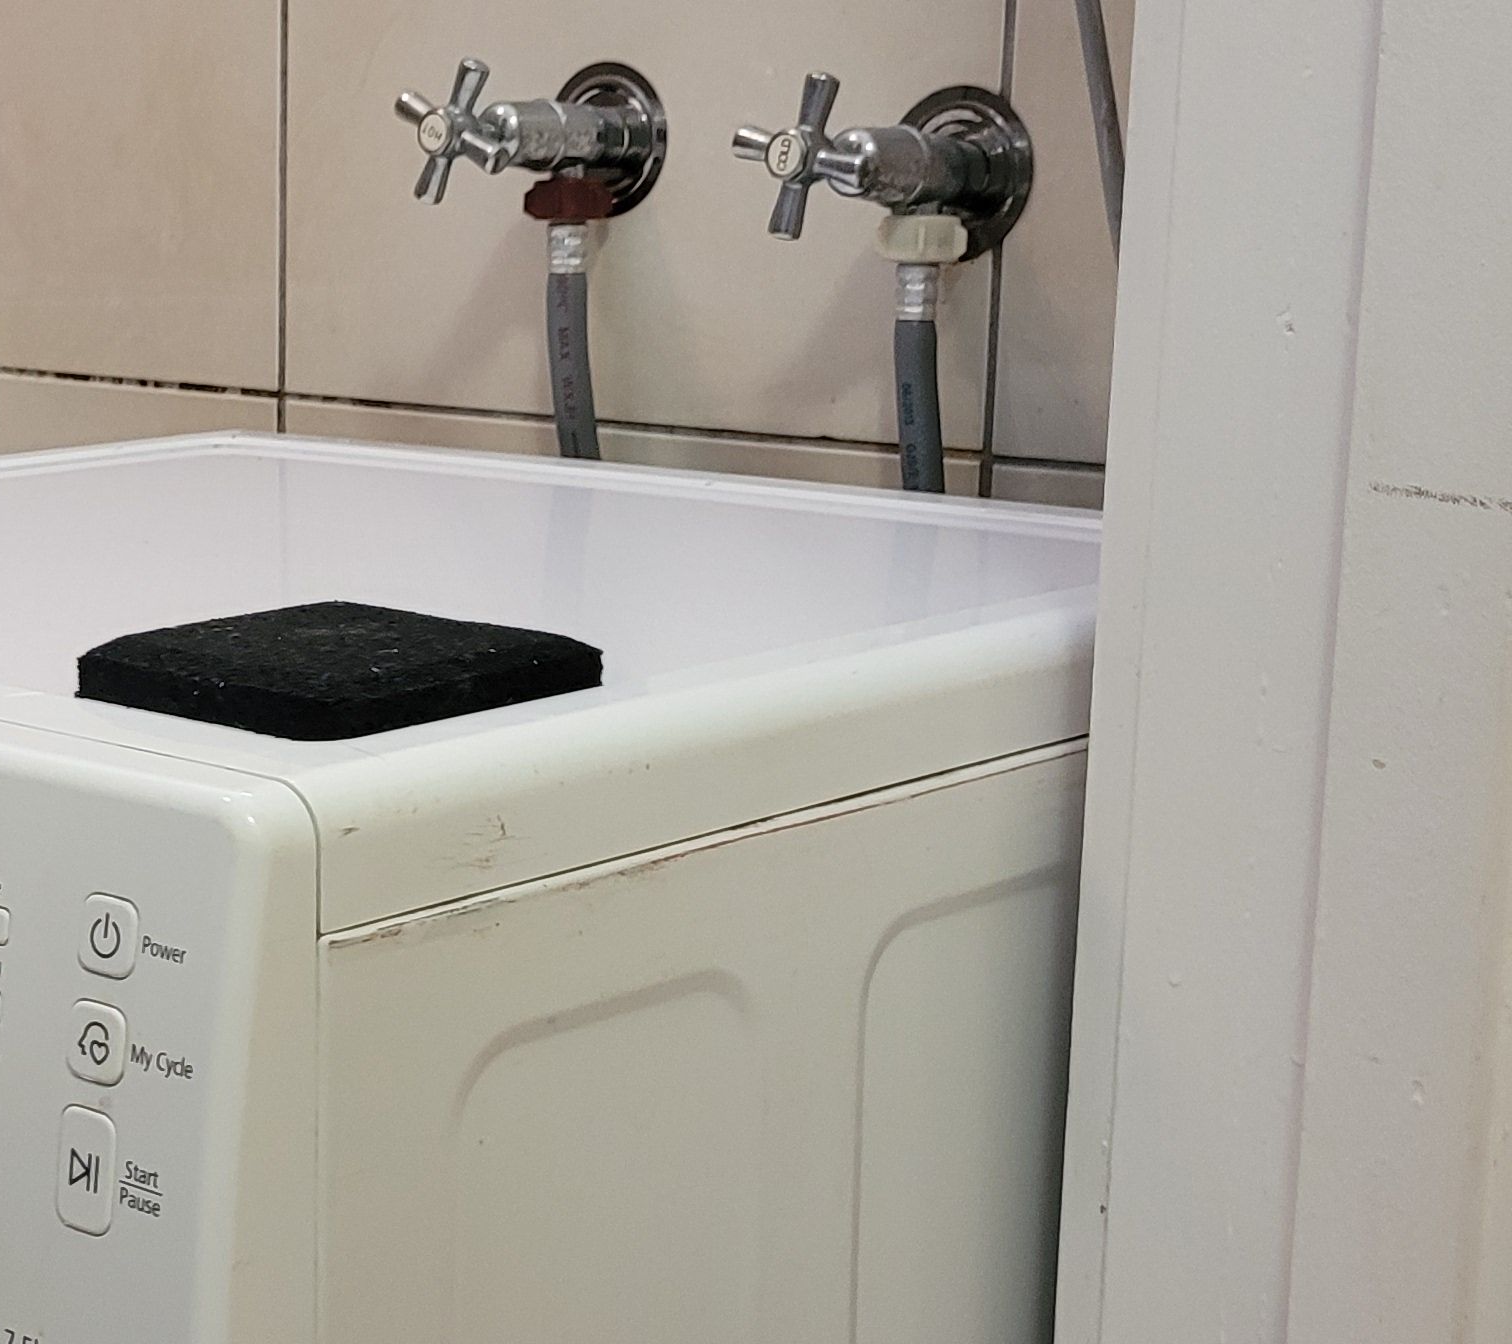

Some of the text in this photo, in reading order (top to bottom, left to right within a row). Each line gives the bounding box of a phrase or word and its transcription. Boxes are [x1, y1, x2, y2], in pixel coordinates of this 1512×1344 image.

[777, 138, 792, 171] COLD
[141, 935, 187, 965] Power
[130, 1043, 194, 1079] My Cycle
[124, 1160, 160, 1189] Start
[119, 1186, 162, 1218] Pause
